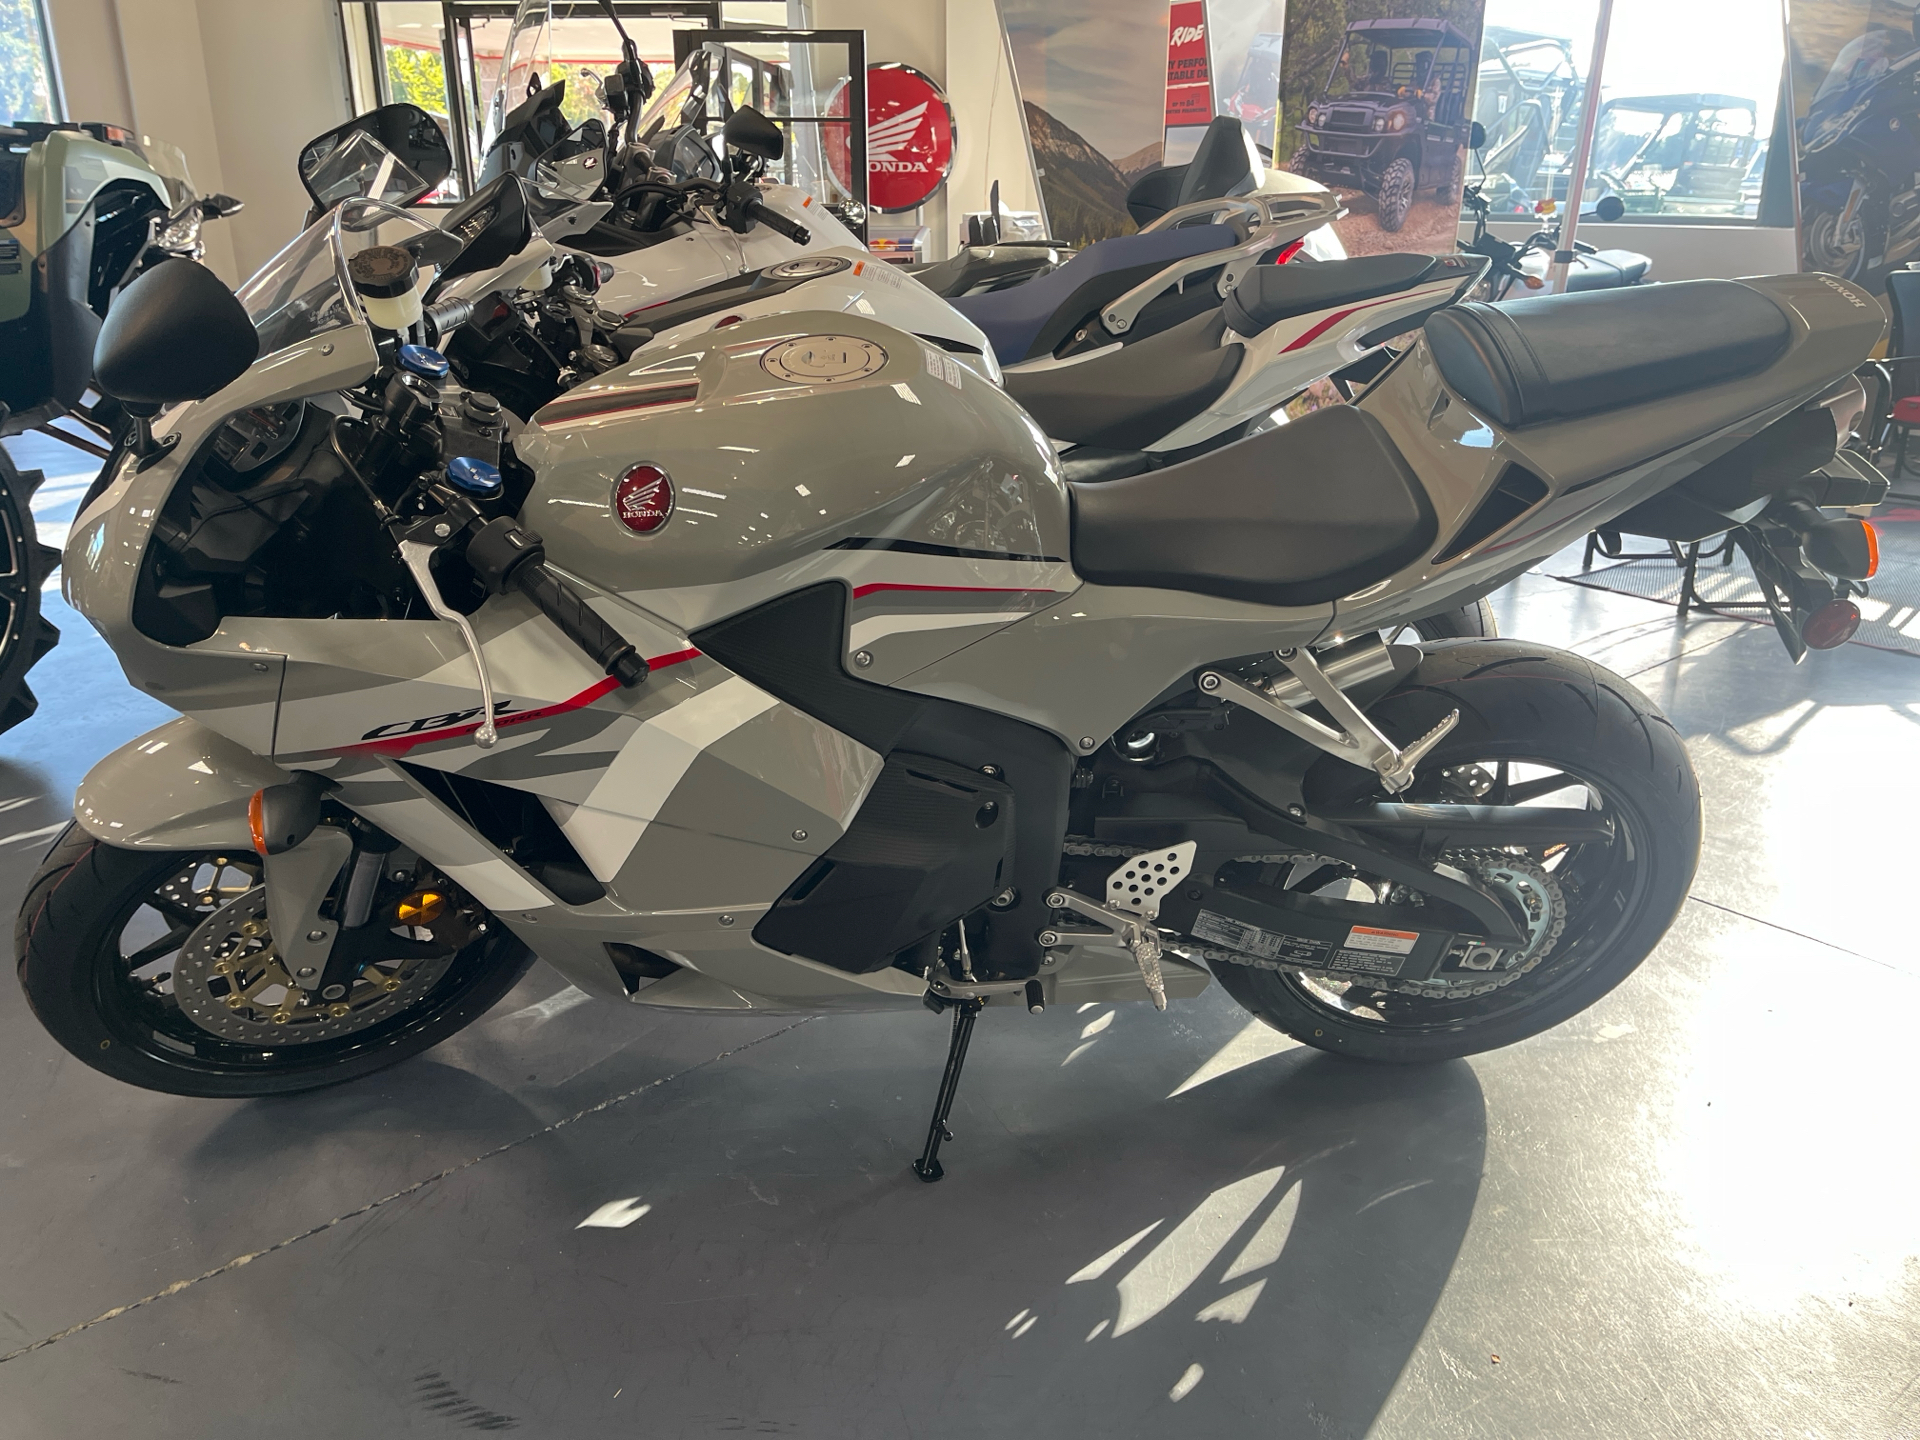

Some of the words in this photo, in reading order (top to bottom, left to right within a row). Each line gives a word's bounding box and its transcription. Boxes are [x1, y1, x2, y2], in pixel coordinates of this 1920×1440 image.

[1170, 24, 1205, 47] RIDE
[869, 161, 929, 173] ONDA
[1818, 276, 1867, 308] HONDA
[622, 508, 665, 519] HONDA
[361, 700, 526, 740] CBR
